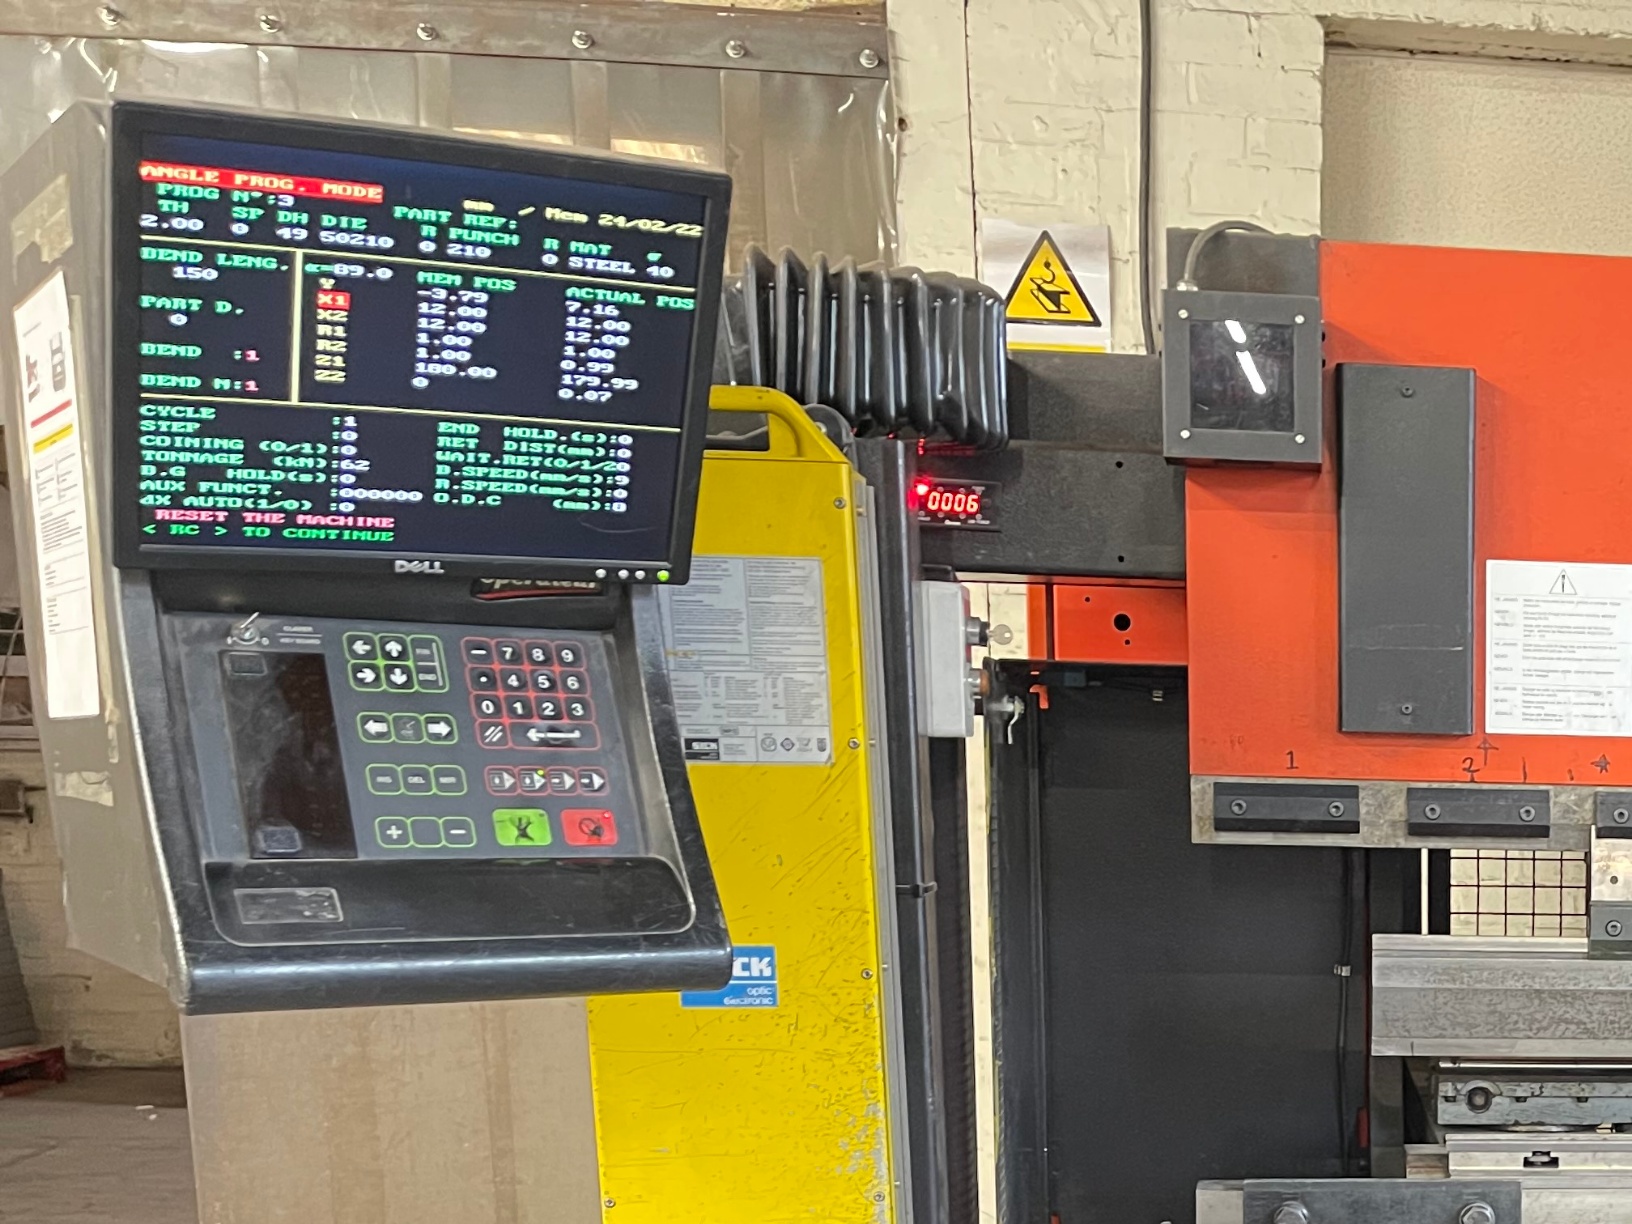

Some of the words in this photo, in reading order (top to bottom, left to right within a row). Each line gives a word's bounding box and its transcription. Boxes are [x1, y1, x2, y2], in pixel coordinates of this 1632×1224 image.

[139, 165, 220, 183] ANGLE
[234, 174, 306, 192] PROG.
[322, 183, 383, 200] MODE
[156, 183, 220, 200] PROG
[157, 200, 189, 214] TH
[231, 206, 265, 220] SP
[277, 210, 309, 225] DH
[320, 214, 367, 231] DIE
[393, 205, 452, 222] PART
[463, 213, 518, 230] REF:
[598, 213, 704, 237] 24/02/22
[138, 214, 205, 231] 2.00
[230, 222, 250, 236] 0
[275, 228, 309, 240] 49
[319, 231, 395, 249] 50210
[420, 224, 437, 238] R
[448, 228, 520, 246] PUNCH
[418, 240, 436, 252] 0
[446, 243, 492, 258] 210
[544, 238, 560, 251] R
[569, 241, 613, 256] MAT
[139, 247, 204, 263] BEND
[215, 252, 289, 272] LENG.
[541, 253, 559, 266] 0
[568, 256, 636, 274] STEEL
[646, 265, 676, 278] 40
[172, 266, 220, 280] 150
[416, 271, 463, 287] MEM
[473, 275, 518, 292] POS
[139, 295, 203, 312] PART
[214, 300, 244, 316] D.
[416, 288, 489, 303] -3.79
[564, 300, 620, 317] 7.16
[565, 286, 646, 306] ACTUAL
[656, 294, 696, 311] POS
[168, 312, 188, 326] 0
[316, 292, 348, 306] X1
[418, 302, 488, 318] 12.00
[566, 316, 632, 332] 12.00
[316, 309, 348, 322] X2
[417, 318, 487, 333] 12.00
[565, 331, 630, 346] 12.00
[139, 342, 203, 358] BEND
[316, 324, 348, 338] R1
[416, 333, 473, 347] 1.00
[563, 345, 616, 360] 1.00
[316, 339, 347, 353] R2
[416, 347, 471, 361] 1.00
[560, 359, 616, 374] 0.99
[139, 373, 202, 389] BEND
[315, 354, 346, 368] Z1
[415, 362, 498, 379] 180.00
[561, 374, 640, 390] 179.99
[411, 375, 430, 388] 0
[558, 387, 613, 401] 0.07
[139, 404, 217, 420] CYCLE
[139, 419, 201, 434] STEP
[436, 420, 482, 436] END
[139, 435, 245, 451] COINING
[436, 435, 480, 450] RET
[140, 450, 245, 466] TONNAGE
[139, 479, 187, 493] AUX
[198, 482, 283, 497] FUNCT.
[926, 490, 980, 513] 0006
[154, 509, 229, 523] RESET
[242, 512, 287, 526] THE
[295, 514, 396, 529] MACHINE
[169, 524, 201, 536] RC
[242, 526, 272, 539] TO
[282, 528, 396, 543] CONTINUE
[394, 560, 446, 575] DELL
[501, 646, 514, 660] 7
[531, 647, 546, 662] 8
[560, 649, 575, 663] 9
[507, 674, 520, 687] 4
[537, 675, 551, 689] 5
[566, 676, 580, 690] 6
[481, 700, 495, 714] 0
[512, 701, 524, 715] 1
[541, 702, 556, 716] 2
[571, 703, 584, 717] 3
[1285, 750, 1300, 770] 1
[1461, 756, 1481, 774] 2
[731, 956, 773, 978] CK
